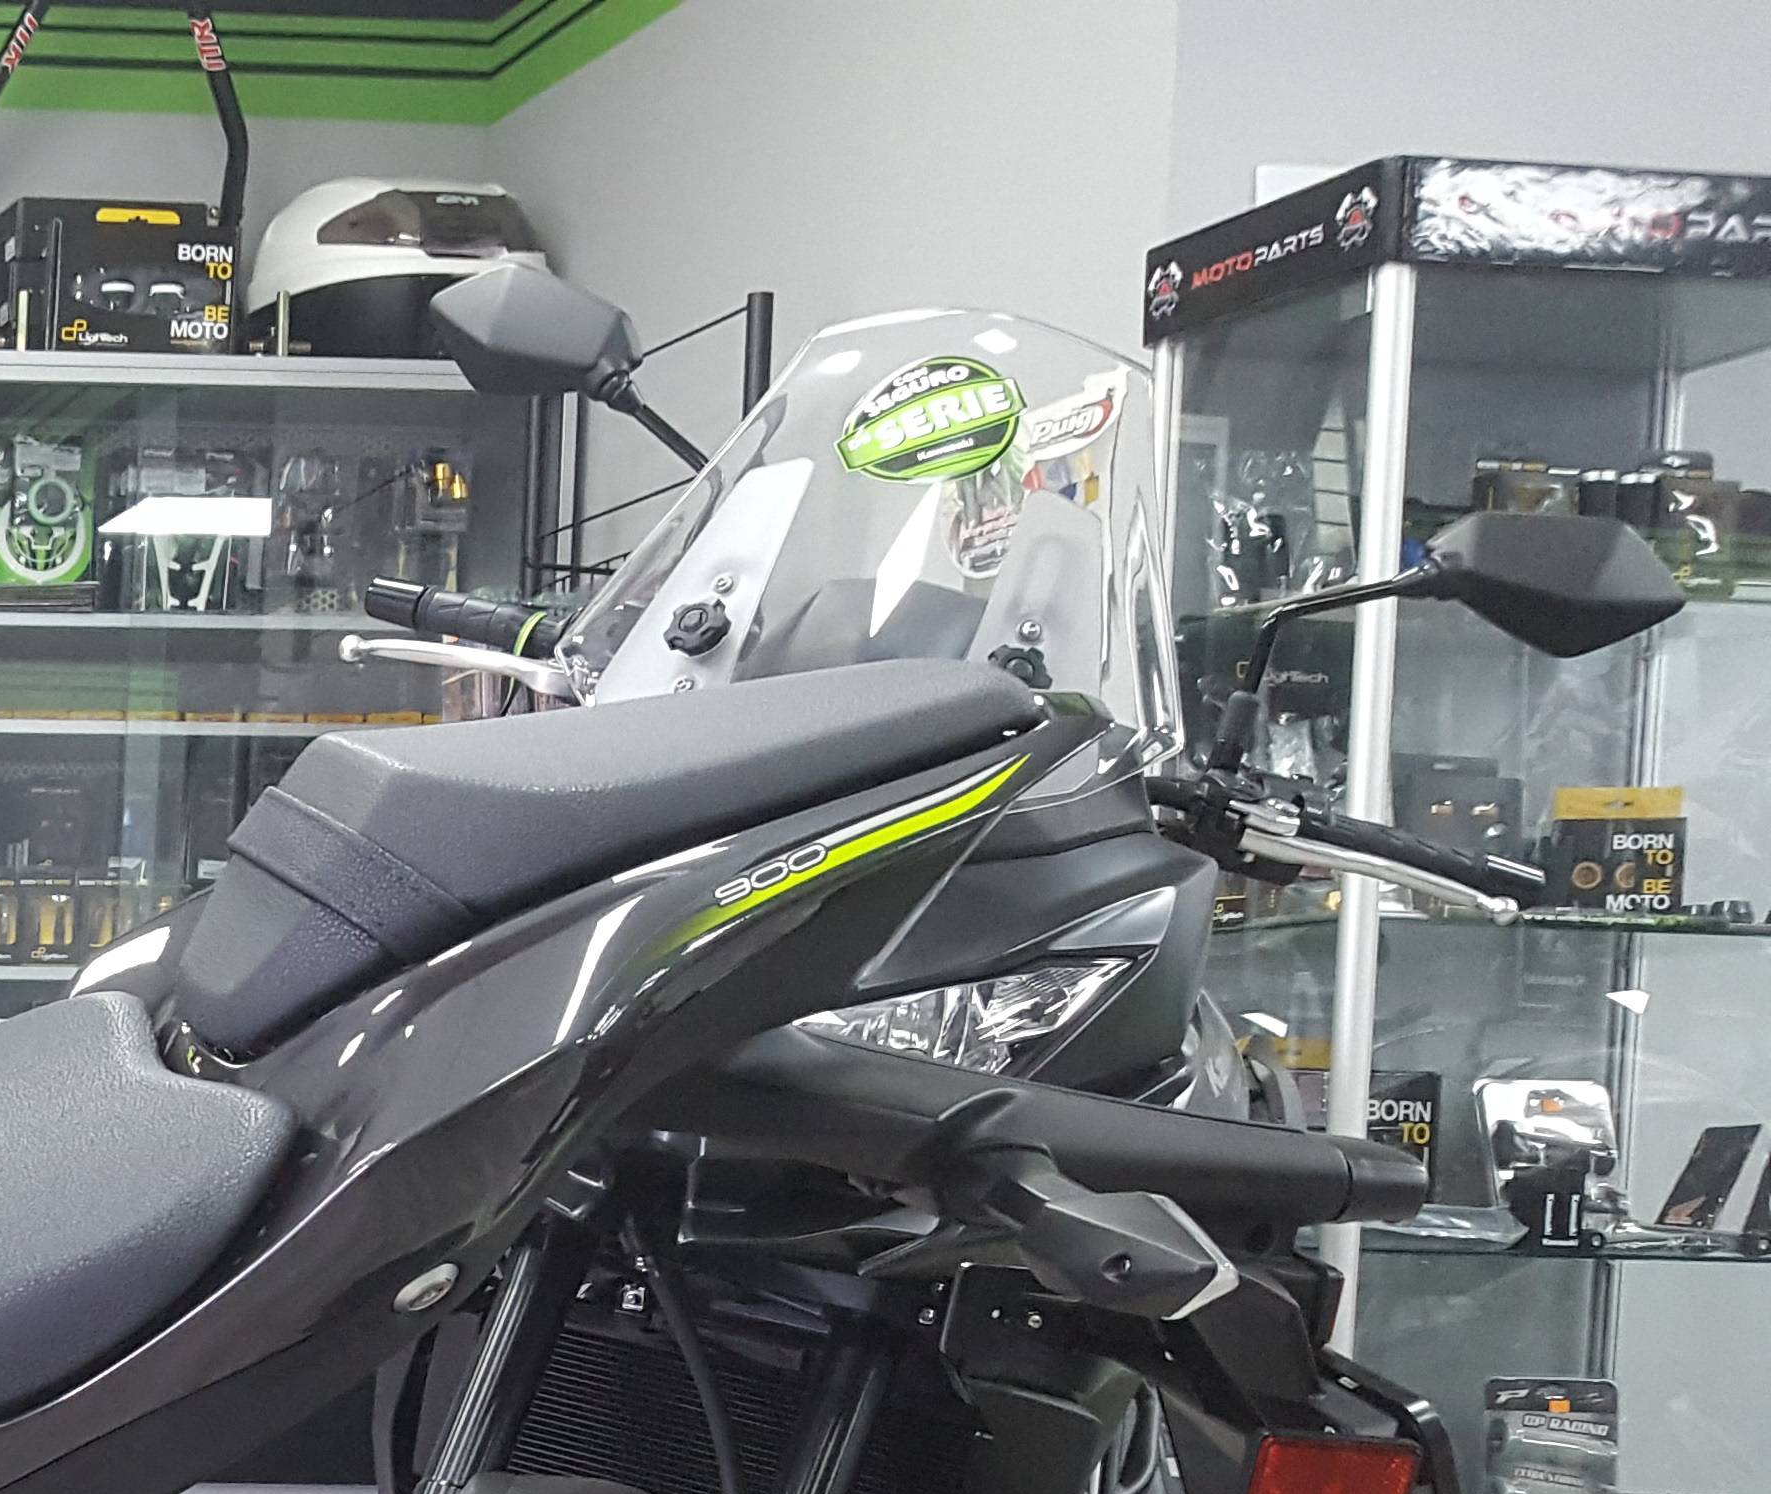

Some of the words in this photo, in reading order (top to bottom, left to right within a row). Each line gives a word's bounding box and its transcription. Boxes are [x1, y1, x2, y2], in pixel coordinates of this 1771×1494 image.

[177, 243, 233, 263] BORN
[207, 263, 233, 279] TO
[203, 304, 230, 322] BE
[170, 320, 228, 340] MOTO
[874, 384, 1011, 450] SERIE
[1030, 404, 1098, 445] Puig
[1612, 833, 1675, 850] BORN
[1645, 849, 1675, 866] TO
[714, 844, 826, 906] 900
[1643, 878, 1672, 894] BE
[1366, 1099, 1432, 1122] BORN
[1400, 1122, 1430, 1144] TO
